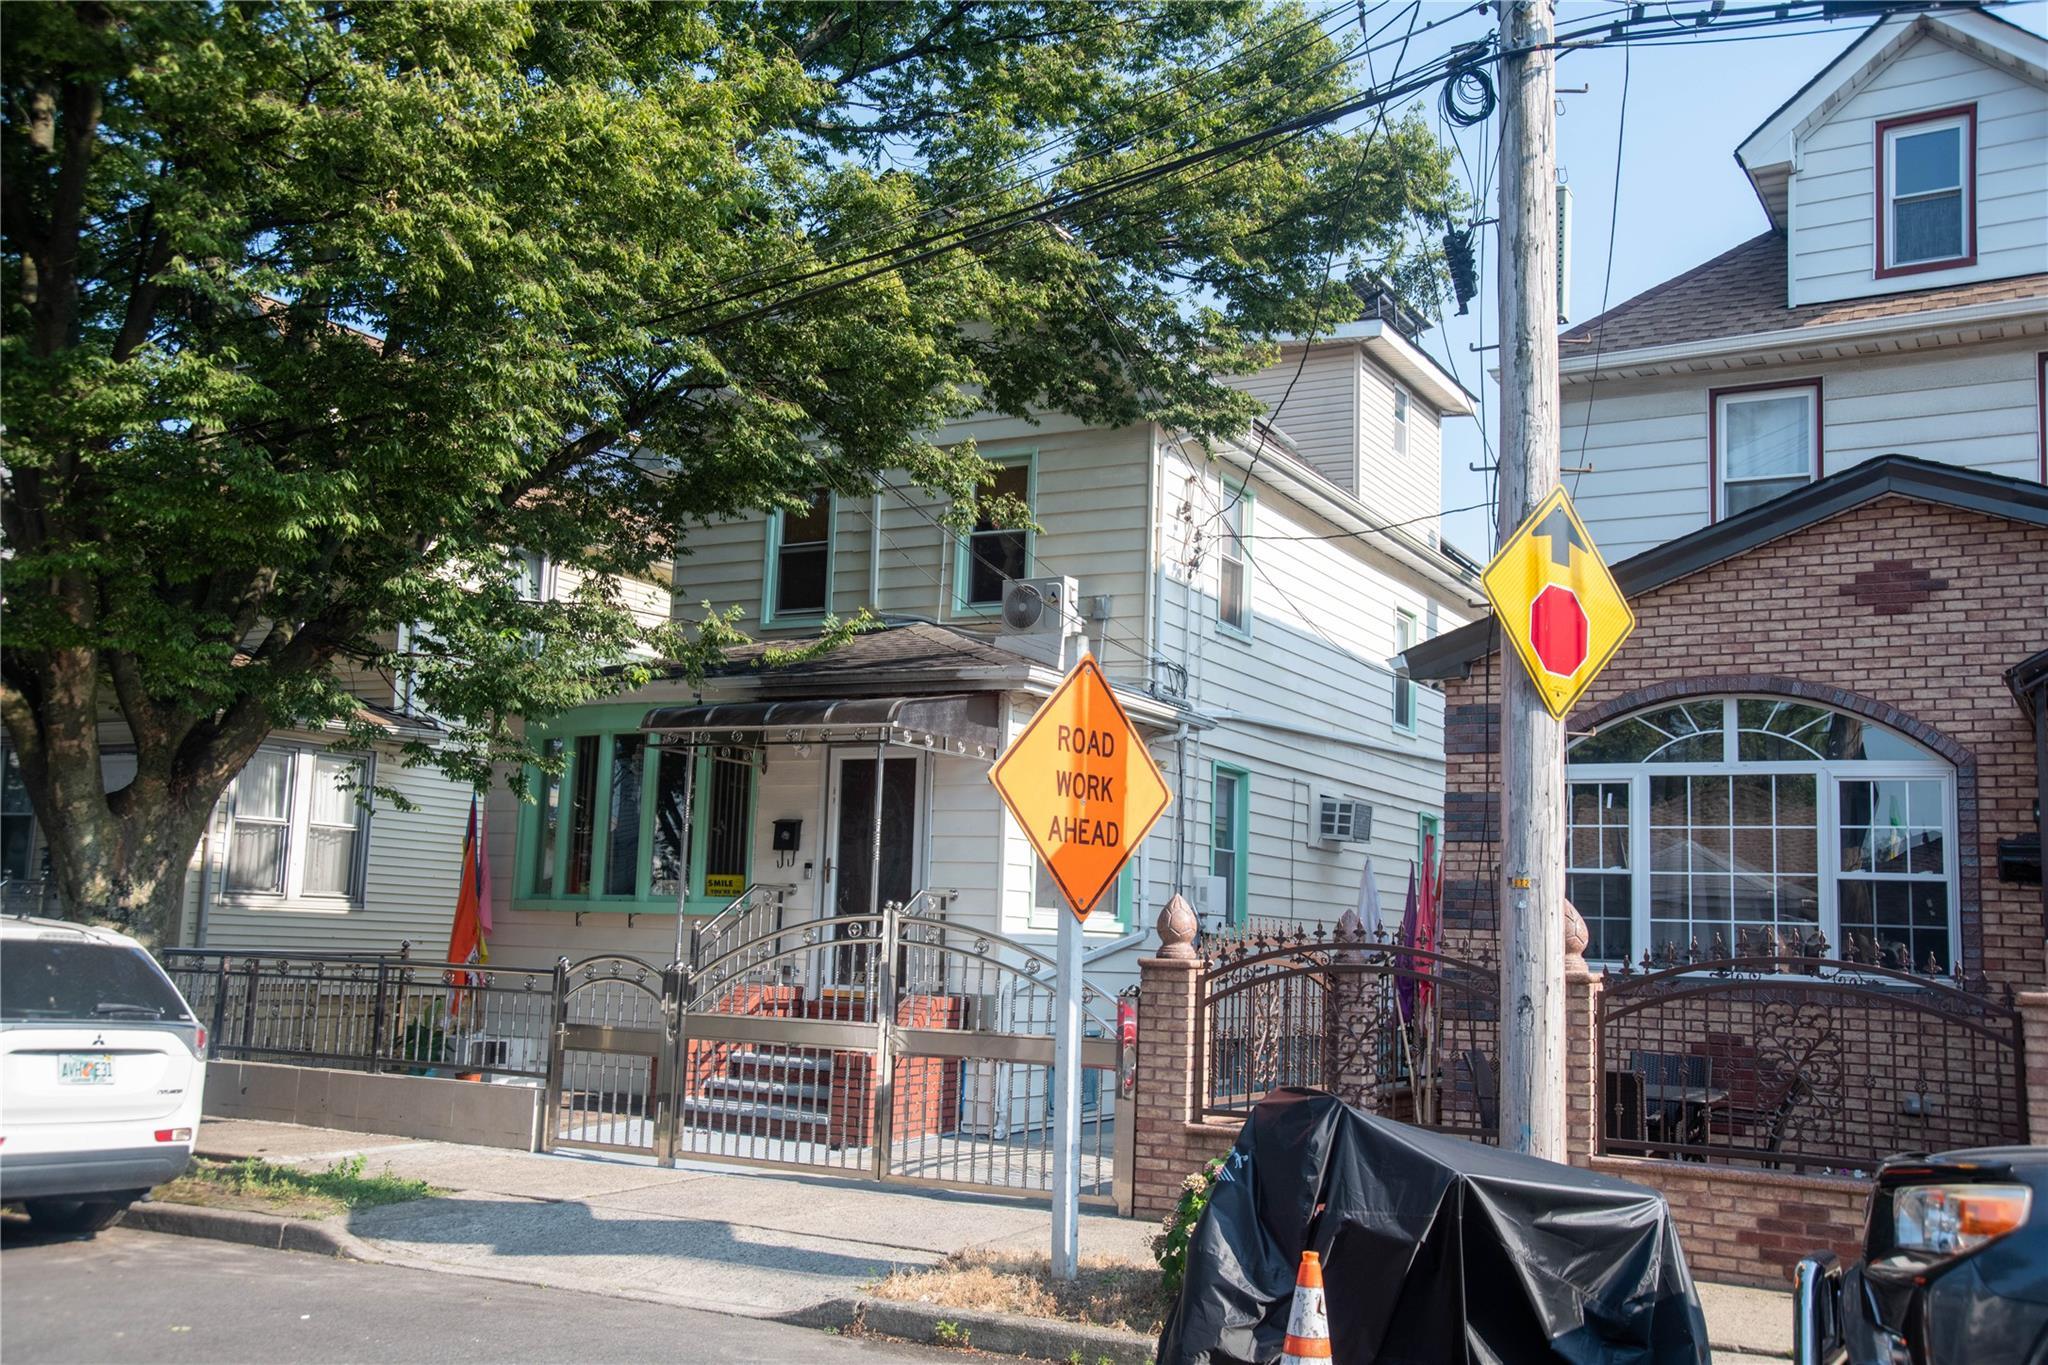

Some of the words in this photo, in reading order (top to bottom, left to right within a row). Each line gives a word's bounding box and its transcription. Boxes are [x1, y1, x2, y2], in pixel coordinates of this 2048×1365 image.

[1058, 725, 1114, 758] ROAD
[1056, 770, 1113, 803] WORK
[1048, 815, 1119, 848] AHEAD
[708, 879, 734, 888] SMILE
